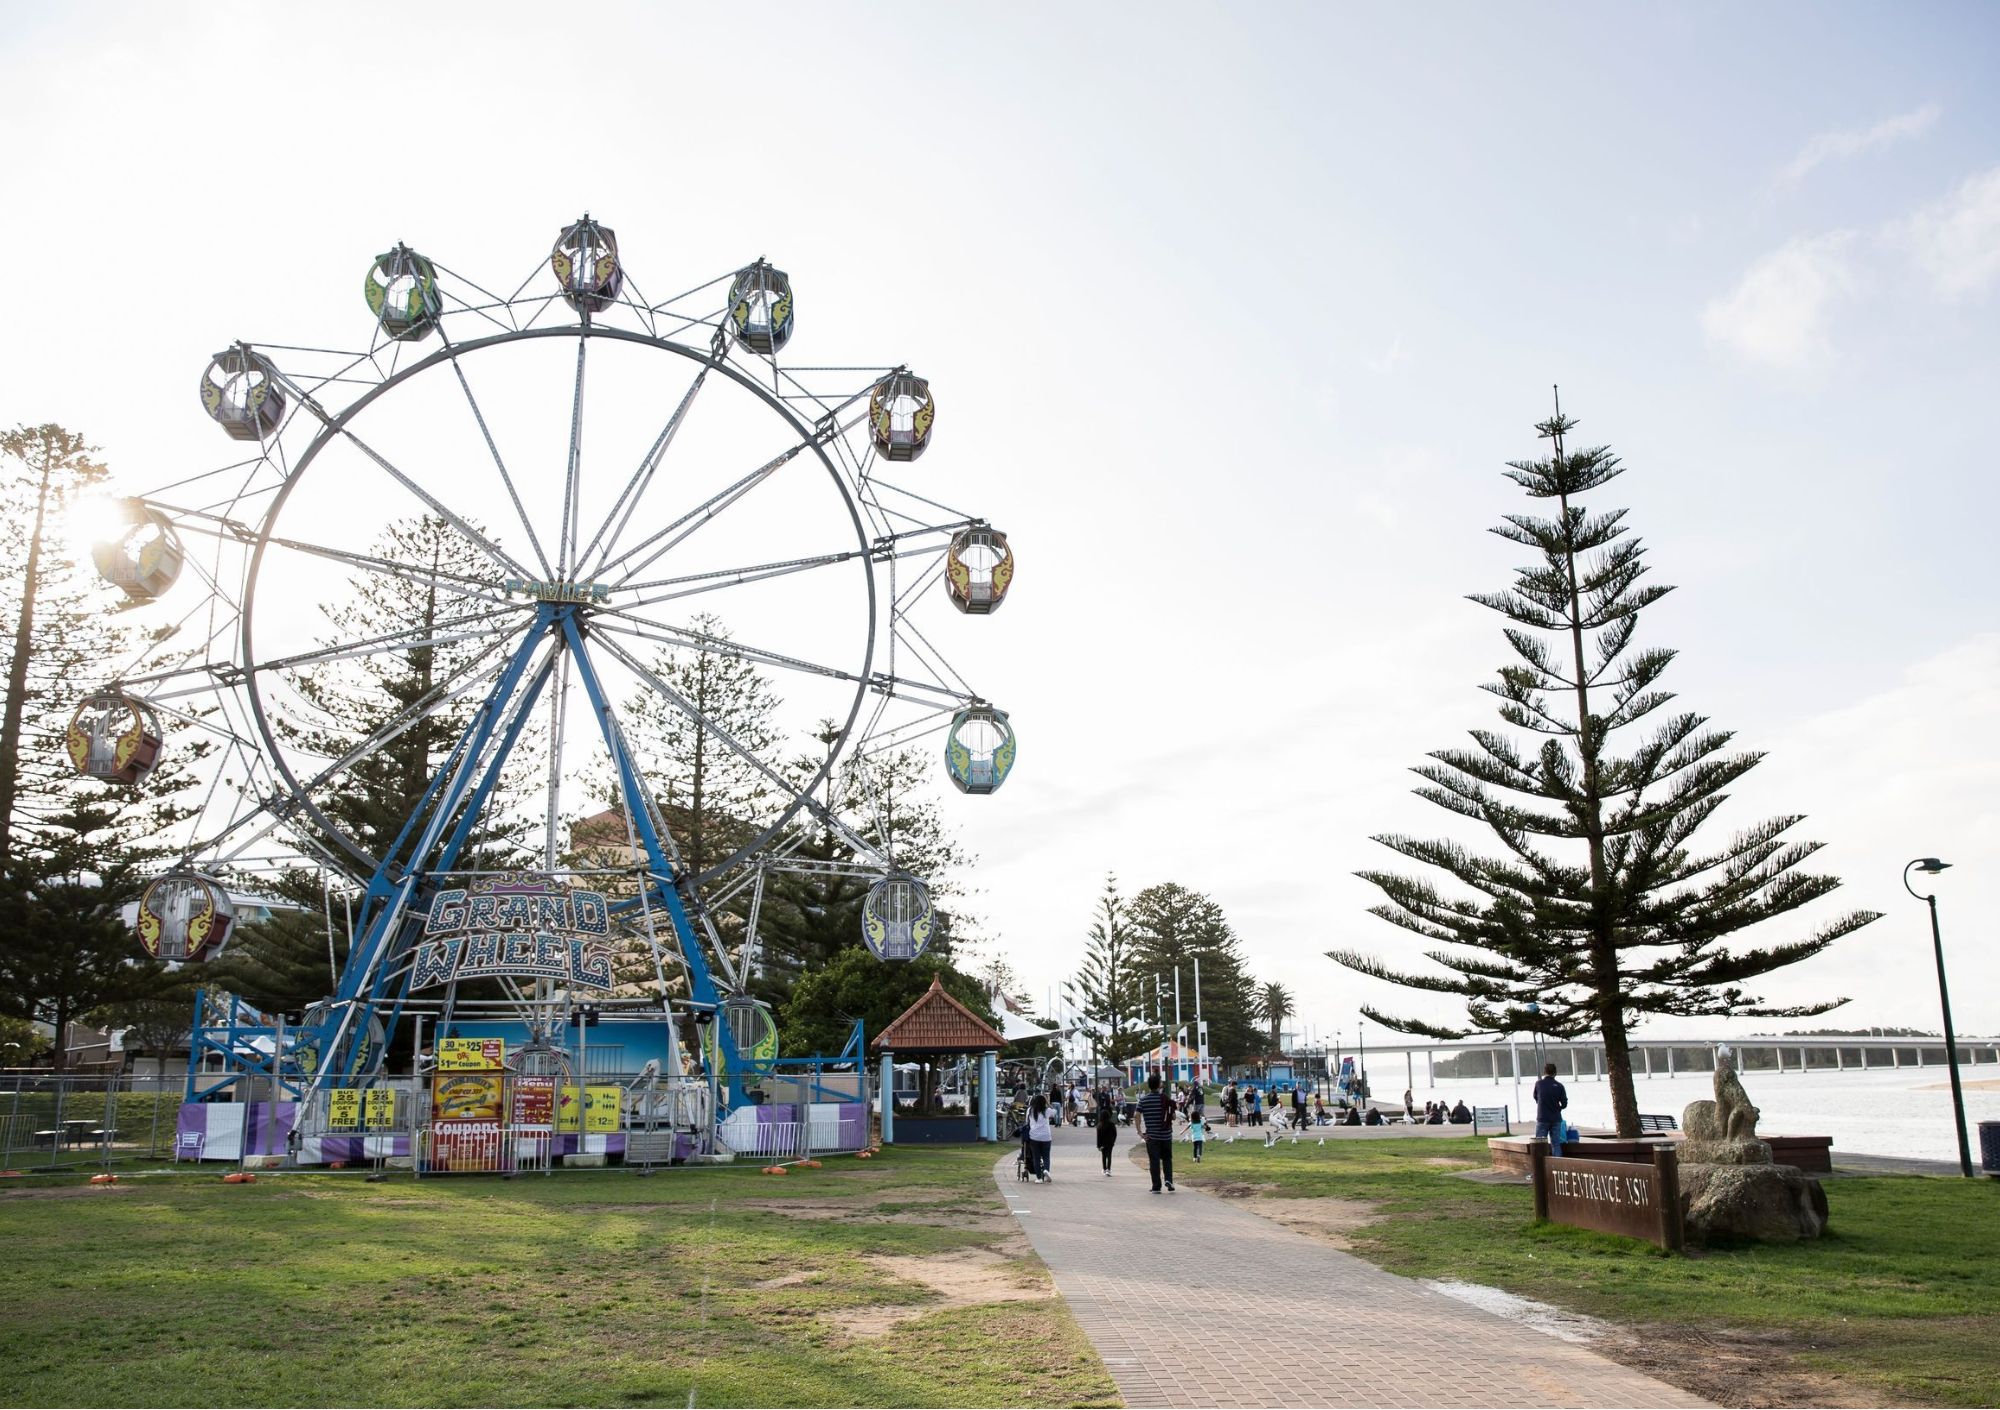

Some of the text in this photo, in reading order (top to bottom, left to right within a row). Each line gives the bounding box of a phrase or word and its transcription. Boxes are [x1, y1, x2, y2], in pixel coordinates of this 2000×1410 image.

[505, 578, 612, 605] PAVIER
[424, 888, 609, 936] GRAND
[409, 933, 616, 992] WHEEL
[467, 1041, 481, 1052] $25
[434, 1121, 499, 1136] Coupons
[598, 1116, 608, 1125] 12
[1552, 1170, 1649, 1207] THE ENTRANCE NSW
